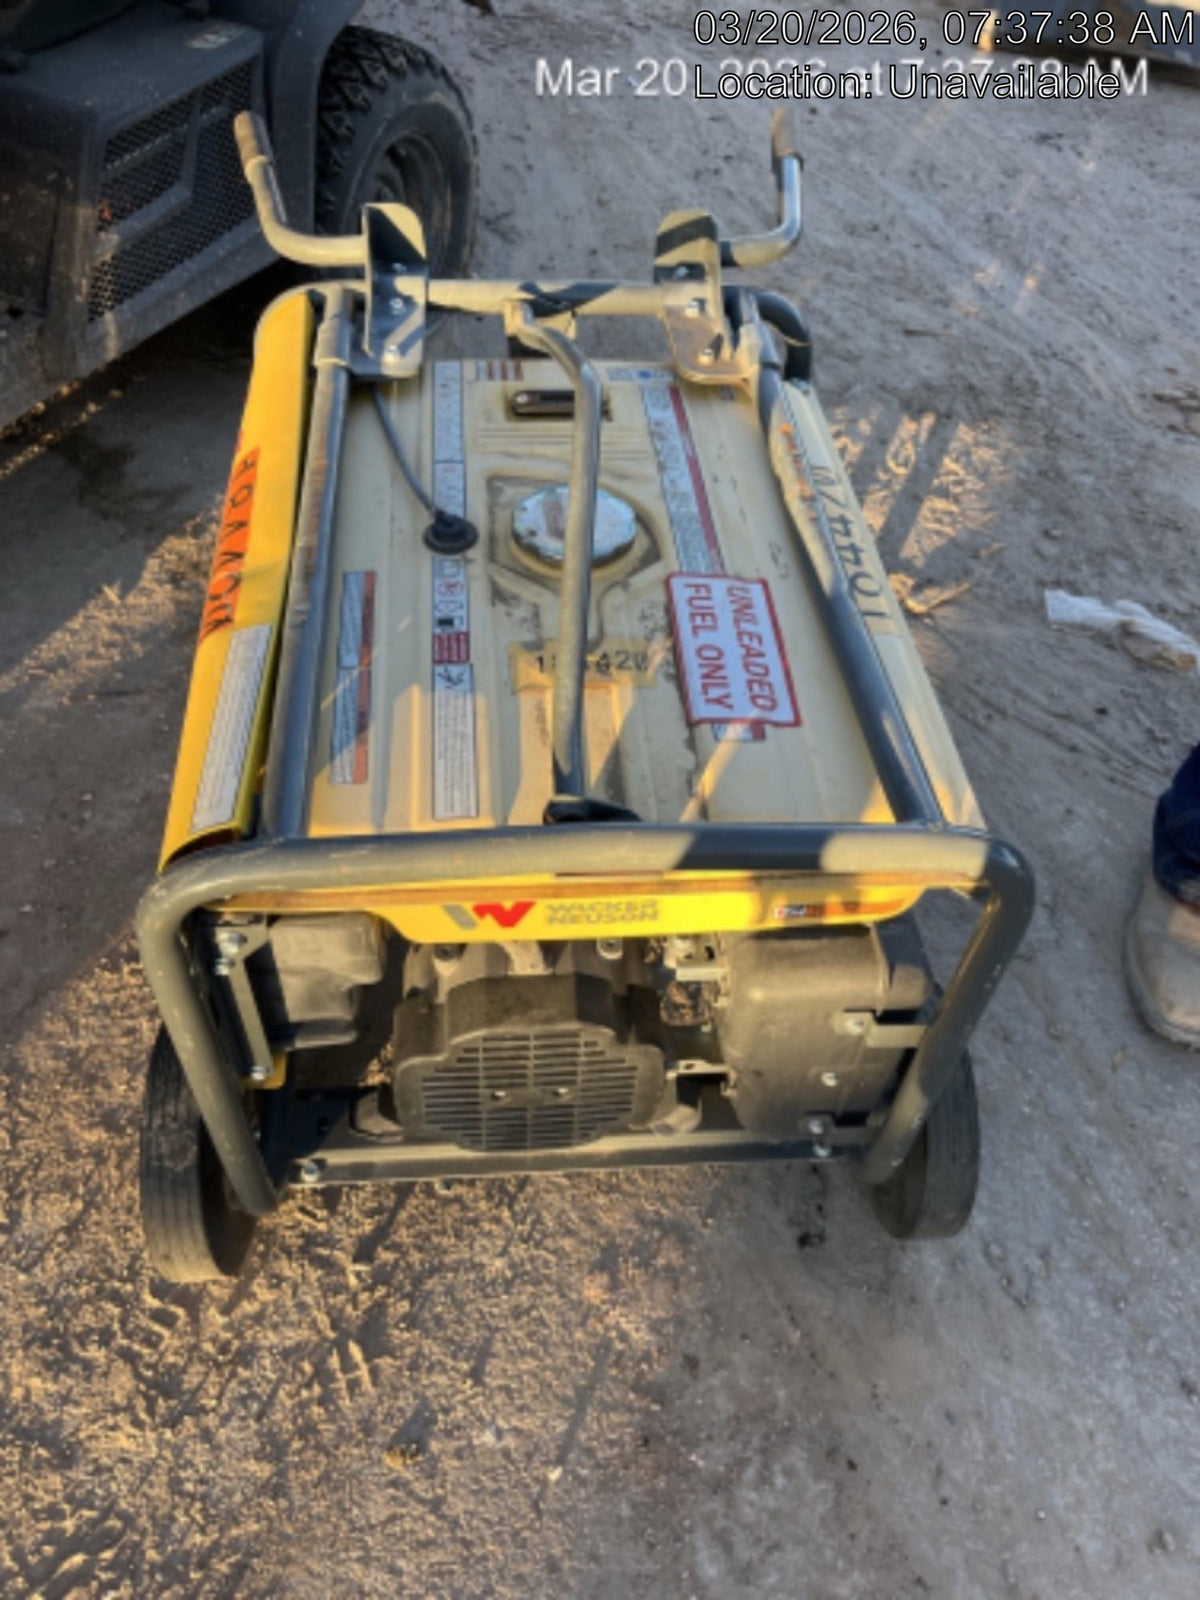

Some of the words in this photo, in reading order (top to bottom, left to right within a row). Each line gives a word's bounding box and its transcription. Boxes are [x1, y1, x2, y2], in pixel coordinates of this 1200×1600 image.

[684, 583, 718, 638] FUEL
[726, 584, 778, 712] UNLEADED
[695, 643, 734, 711] ONLY
[545, 899, 660, 914] WACKER
[546, 908, 660, 926] NEUSON
